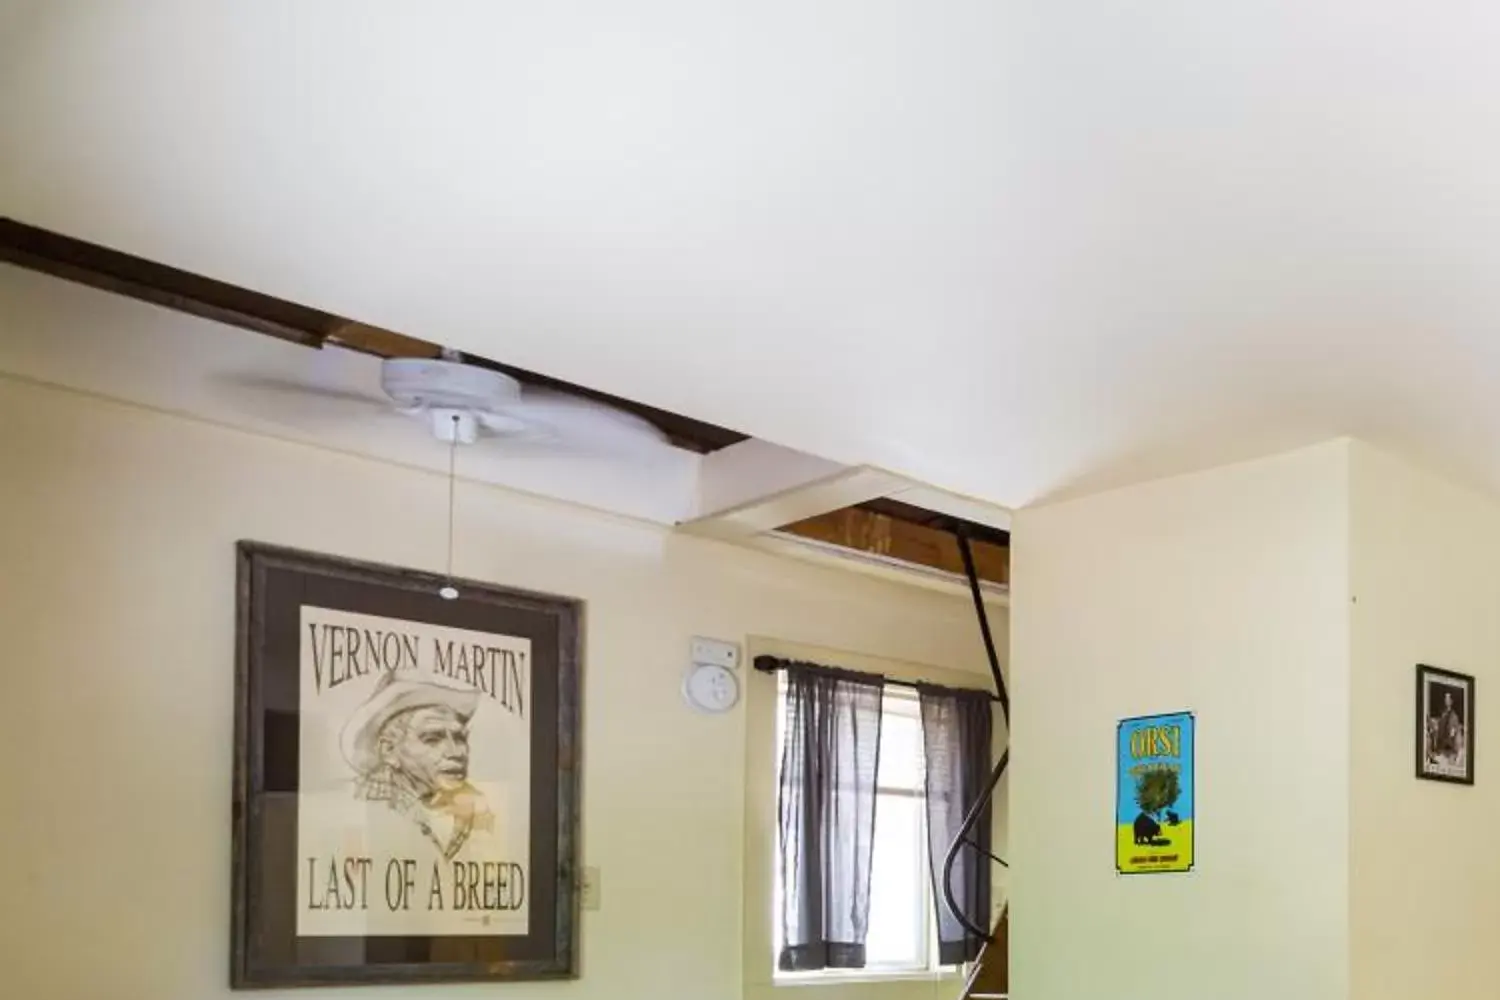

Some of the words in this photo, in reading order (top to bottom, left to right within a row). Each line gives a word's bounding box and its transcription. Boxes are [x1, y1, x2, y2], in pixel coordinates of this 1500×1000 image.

[309, 623, 420, 695] VERNON
[433, 638, 526, 718] MARTIN
[307, 856, 373, 911] LAST
[385, 858, 417, 912] OF
[427, 861, 444, 911] A
[452, 860, 525, 912] BREED
